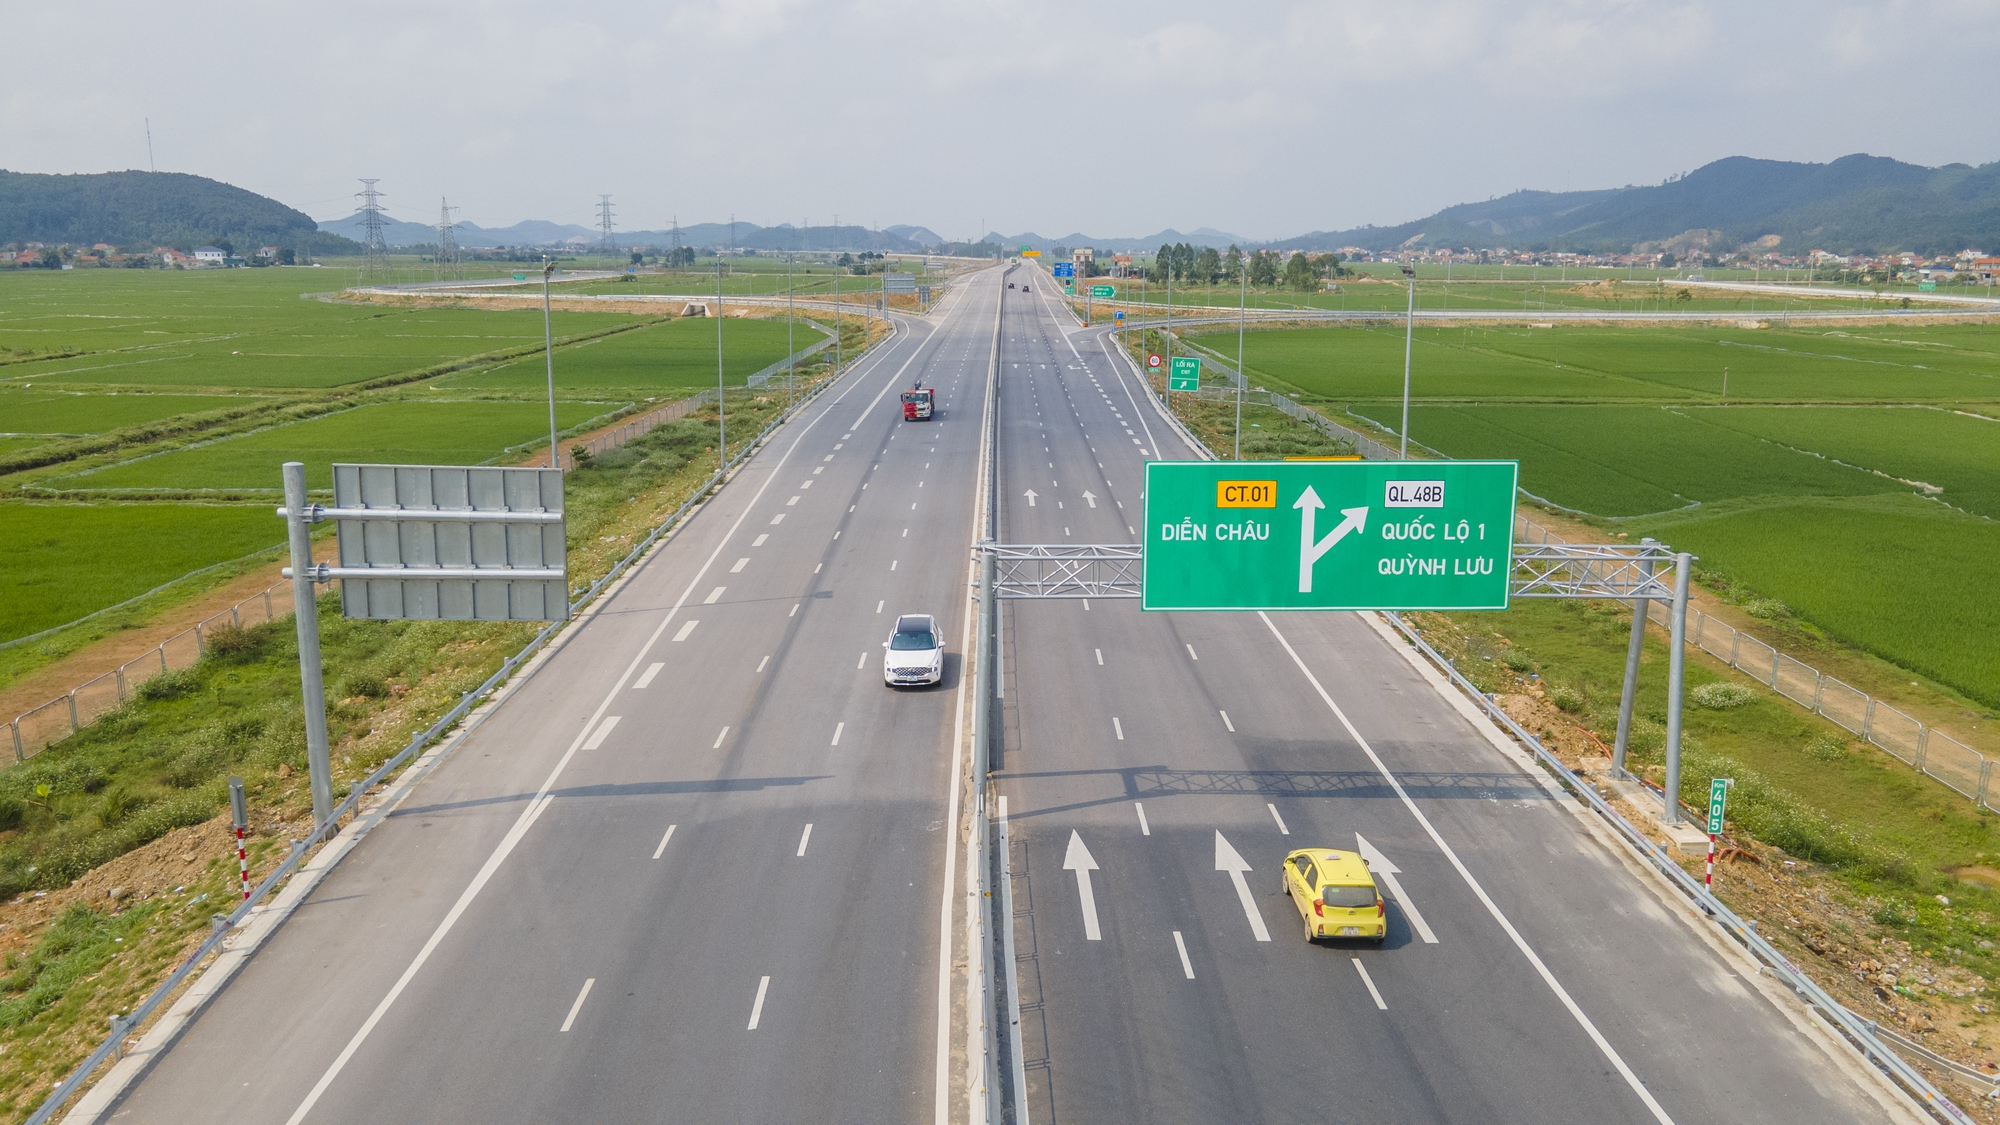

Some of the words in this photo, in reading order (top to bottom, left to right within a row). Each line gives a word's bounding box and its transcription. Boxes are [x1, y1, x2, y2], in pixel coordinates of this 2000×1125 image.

[1176, 360, 1185, 368] LỐI
[1225, 486, 1269, 502] CT.01
[1388, 486, 1442, 502] QL.48B
[1161, 516, 1207, 541] DIỄN
[1215, 520, 1270, 541] CHÂU
[1382, 515, 1435, 540] QUỐC
[1444, 519, 1470, 544] LỘ
[1478, 523, 1485, 540] 1
[1378, 553, 1446, 576] QUỲNH
[1454, 556, 1494, 576] LƯU
